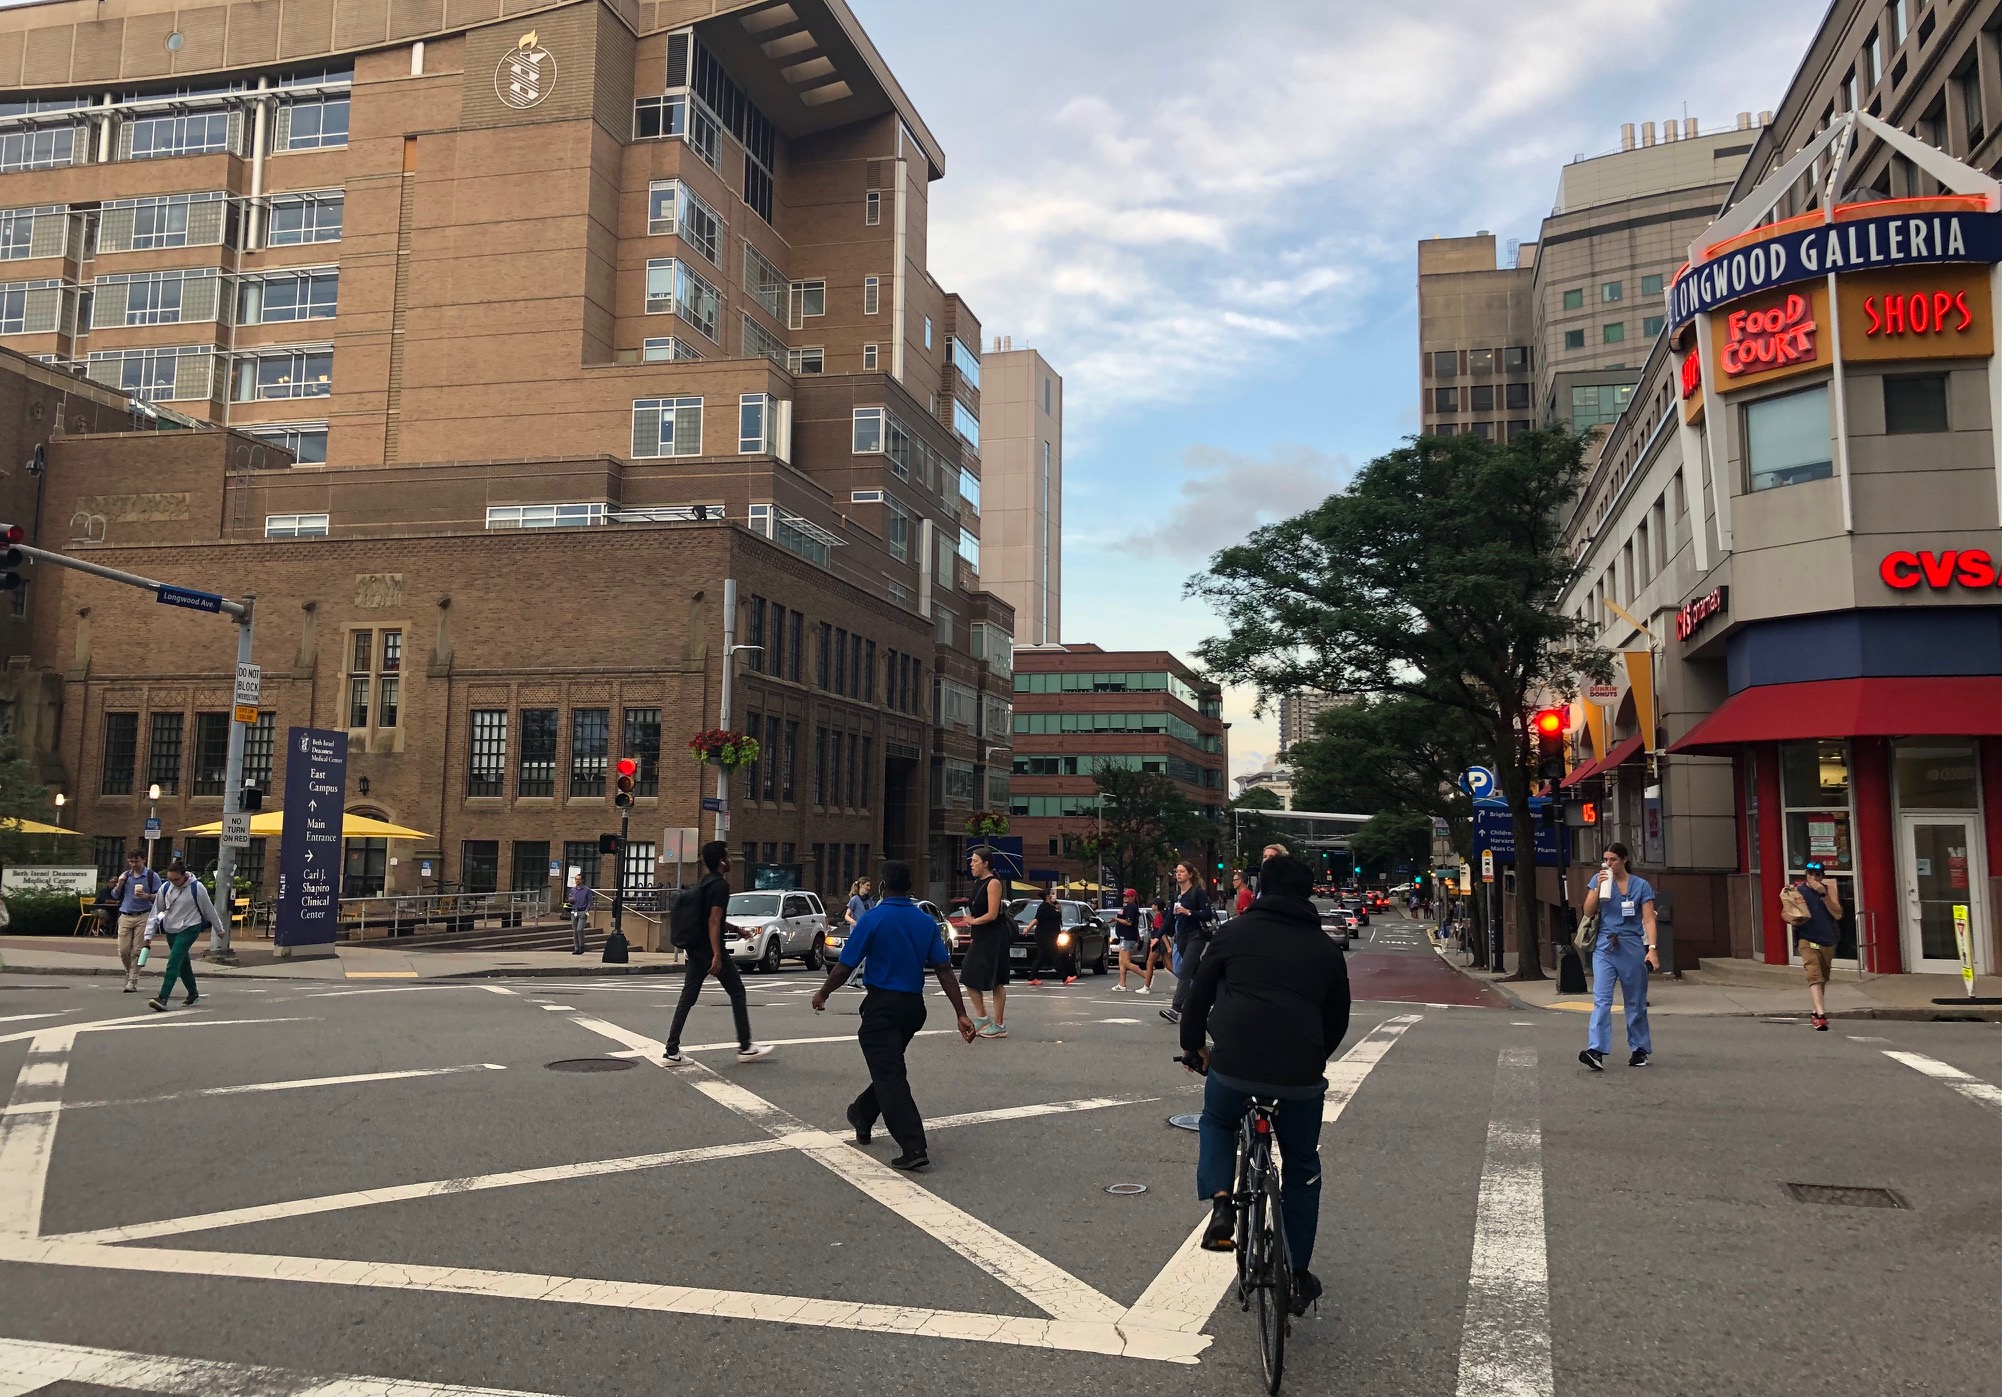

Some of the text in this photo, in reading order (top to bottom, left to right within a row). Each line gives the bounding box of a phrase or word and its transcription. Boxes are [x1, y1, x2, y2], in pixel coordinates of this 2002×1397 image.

[1674, 243, 1787, 322] LONGWOOD
[1800, 217, 1966, 271] GALLERIA
[1728, 294, 1806, 342] FOOD
[1863, 289, 1972, 337] SHOPS
[1720, 320, 1817, 375] COURT
[164, 591, 215, 608] Longwood Ave.
[238, 667, 259, 679] DO NOT
[237, 681, 259, 692] BLOCK
[310, 768, 326, 779] East
[309, 781, 338, 795] Campus
[1583, 803, 1596, 822] 15
[231, 817, 242, 825] NO
[306, 818, 326, 829] Main
[227, 826, 246, 834] TURN
[223, 834, 235, 842] ON
[306, 831, 337, 842] Entrance
[303, 869, 326, 881] Carl J.
[302, 882, 330, 896] Shapiro
[301, 895, 330, 907] Clinical
[300, 908, 326, 919] Center
